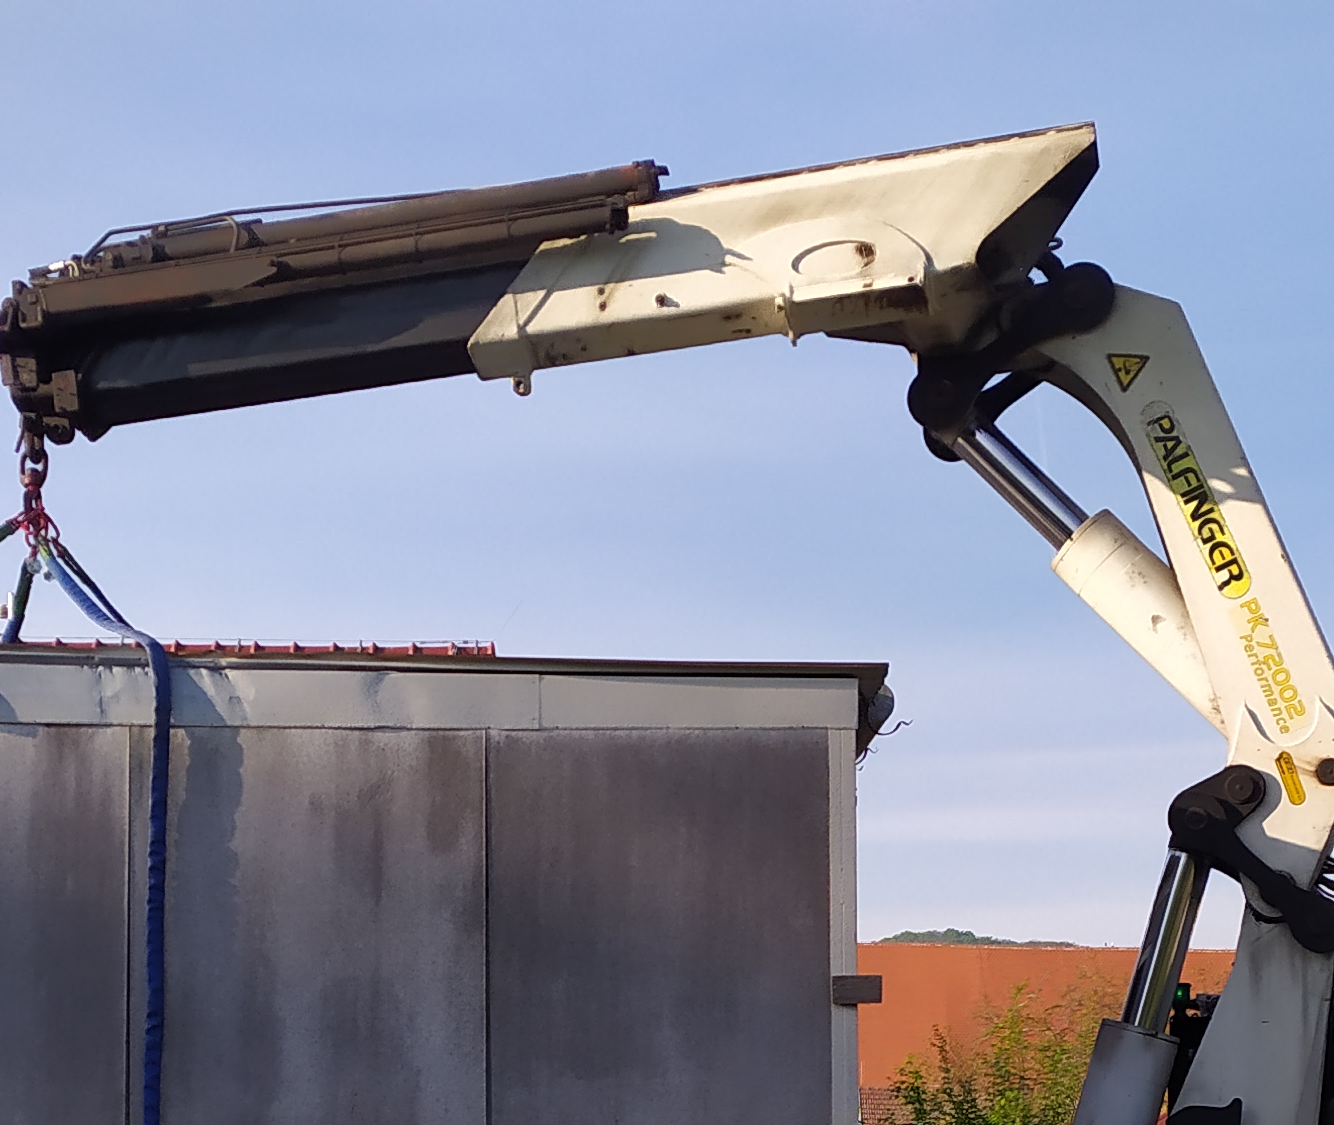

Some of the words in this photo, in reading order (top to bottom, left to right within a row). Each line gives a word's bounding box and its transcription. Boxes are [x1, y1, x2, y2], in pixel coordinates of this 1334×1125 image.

[1146, 413, 1245, 592] PALFINGER
[1239, 597, 1269, 634] PK
[1255, 634, 1306, 720] 72002
[1239, 633, 1291, 734] Performance
